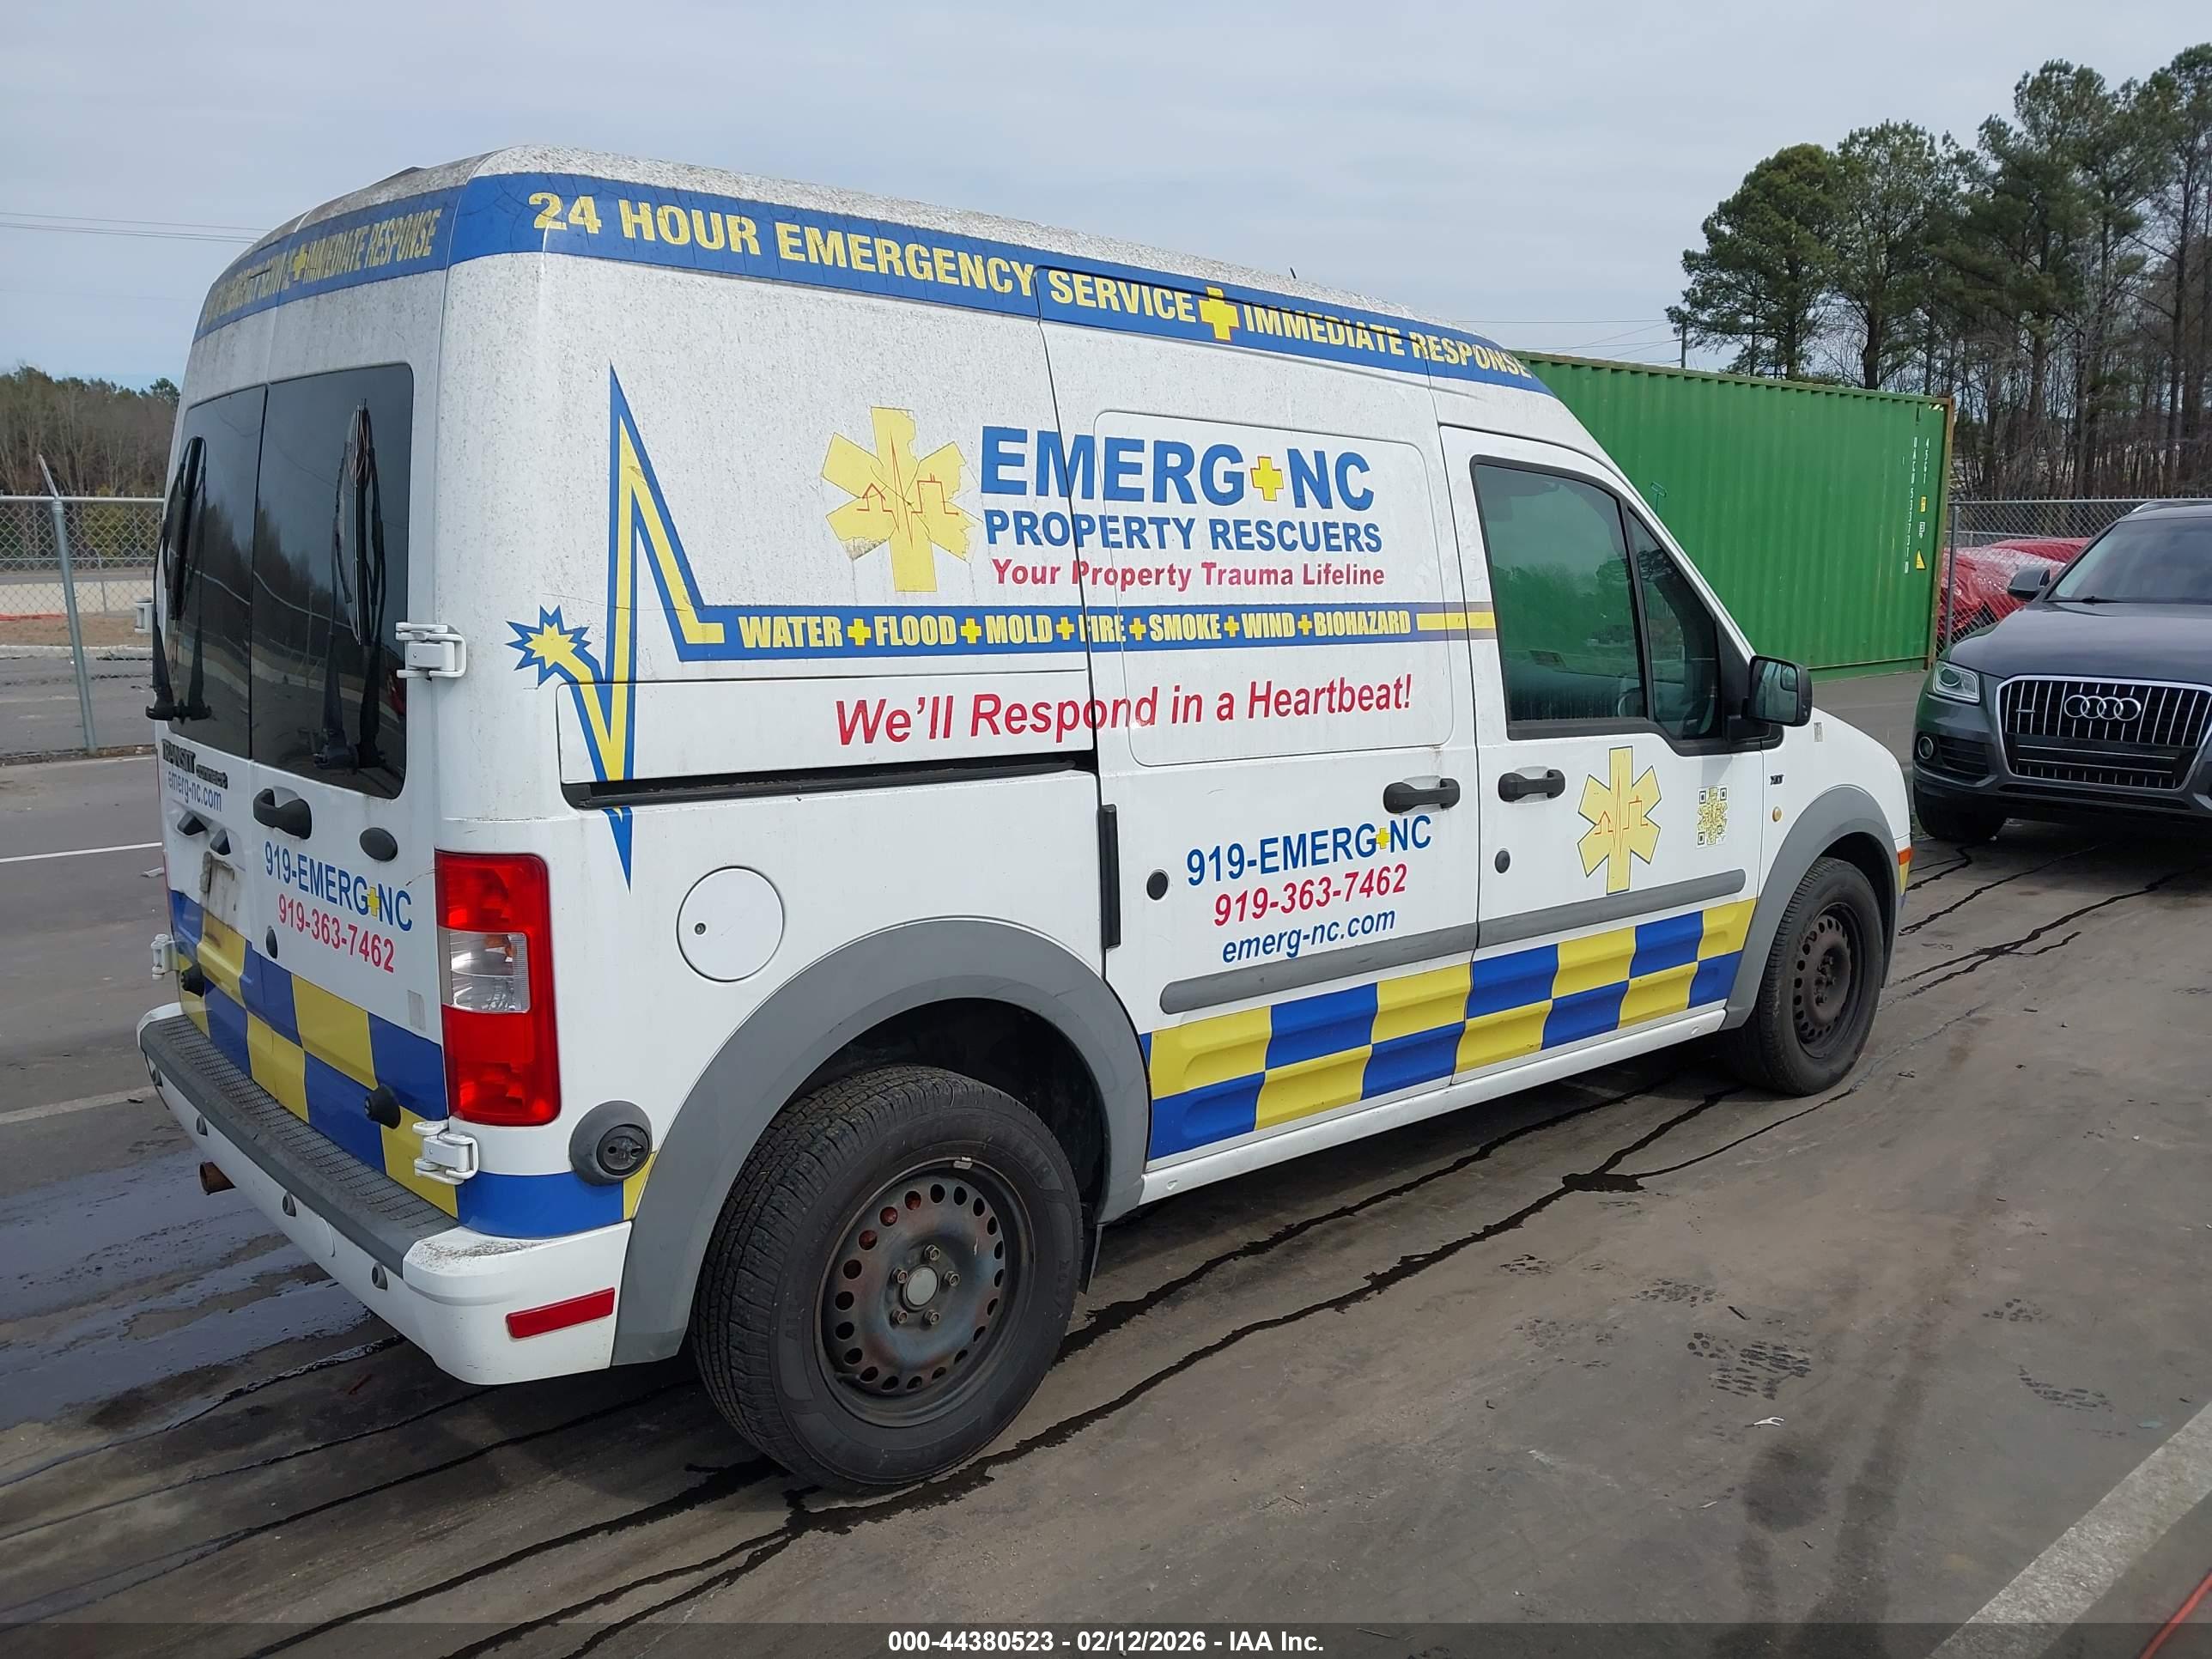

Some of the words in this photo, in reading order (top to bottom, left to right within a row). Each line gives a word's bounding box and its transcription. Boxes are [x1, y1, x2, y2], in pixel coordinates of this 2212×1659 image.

[364, 209, 442, 268] RESPONSE
[527, 192, 601, 235] 24
[618, 199, 762, 255] HOUR
[775, 222, 1034, 297] EMERGENCY
[1048, 270, 1197, 323] SERVICE
[1243, 303, 1406, 356] IMMEDIATE
[1408, 331, 1533, 379] RESPONSE
[980, 426, 1245, 506] EMERG
[1287, 447, 1375, 512] NC
[986, 509, 1194, 550] PROPERTY
[1210, 518, 1382, 552] RESCUERS
[993, 559, 1061, 585] Your
[1073, 560, 1192, 592] Property
[1202, 562, 1293, 586] Trauma
[1303, 563, 1385, 586] Lifeline
[738, 616, 843, 648] WATER
[874, 615, 957, 647] FLOOD
[985, 615, 1052, 644] MOLD
[1079, 613, 1126, 643] FIRE
[1150, 613, 1222, 641] SMOKE
[1241, 612, 1296, 639] WIND
[1314, 611, 1411, 636] BIOHAZARD
[836, 696, 953, 745] We'll
[970, 687, 1158, 744] Respond
[1170, 685, 1202, 724] in
[1216, 694, 1235, 721] a
[1248, 673, 1413, 719] Heartbeat!
[167, 770, 222, 812] emerg-nc.com
[1213, 863, 1407, 927] 919-363-7462
[278, 894, 394, 973] 919-363-7462
[1222, 910, 1395, 964] emerg-nc.com
